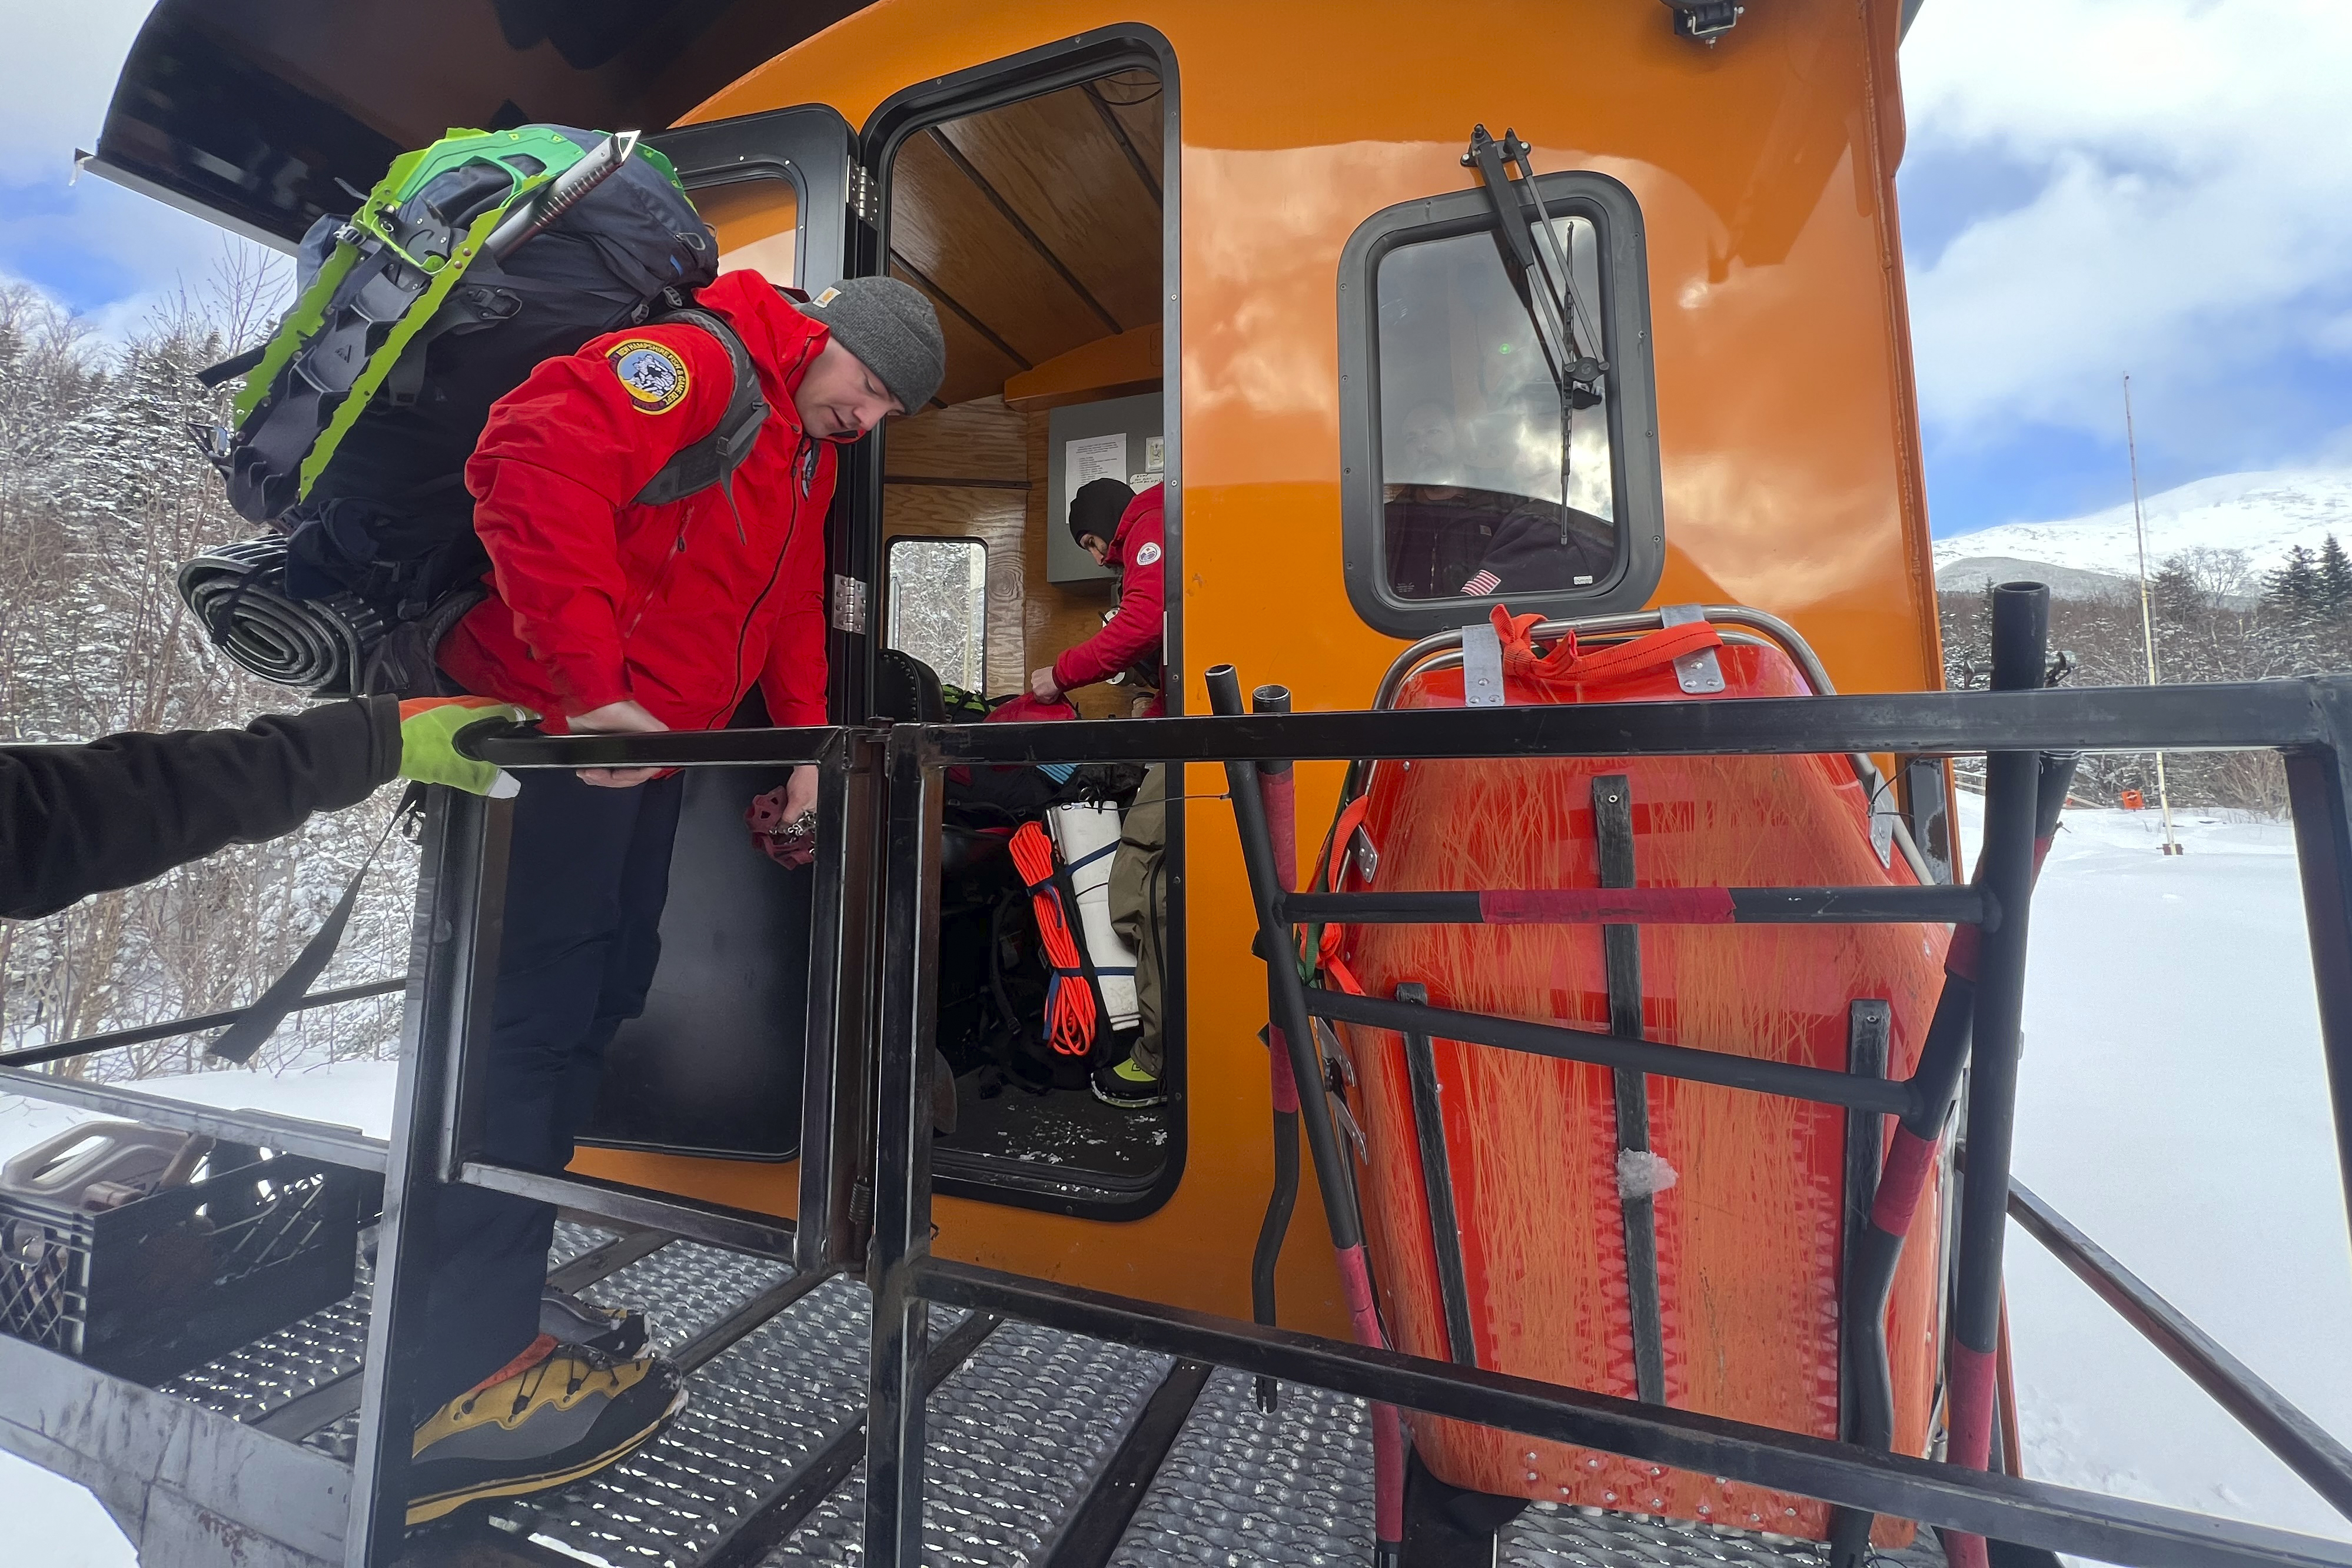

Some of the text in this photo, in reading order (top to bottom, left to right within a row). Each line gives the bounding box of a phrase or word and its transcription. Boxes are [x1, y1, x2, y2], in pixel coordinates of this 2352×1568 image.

[616, 346, 631, 357] NEW
[627, 343, 670, 358] HAMPSHIRE
[667, 355, 682, 369] FISH
[674, 376, 686, 394] GAME
